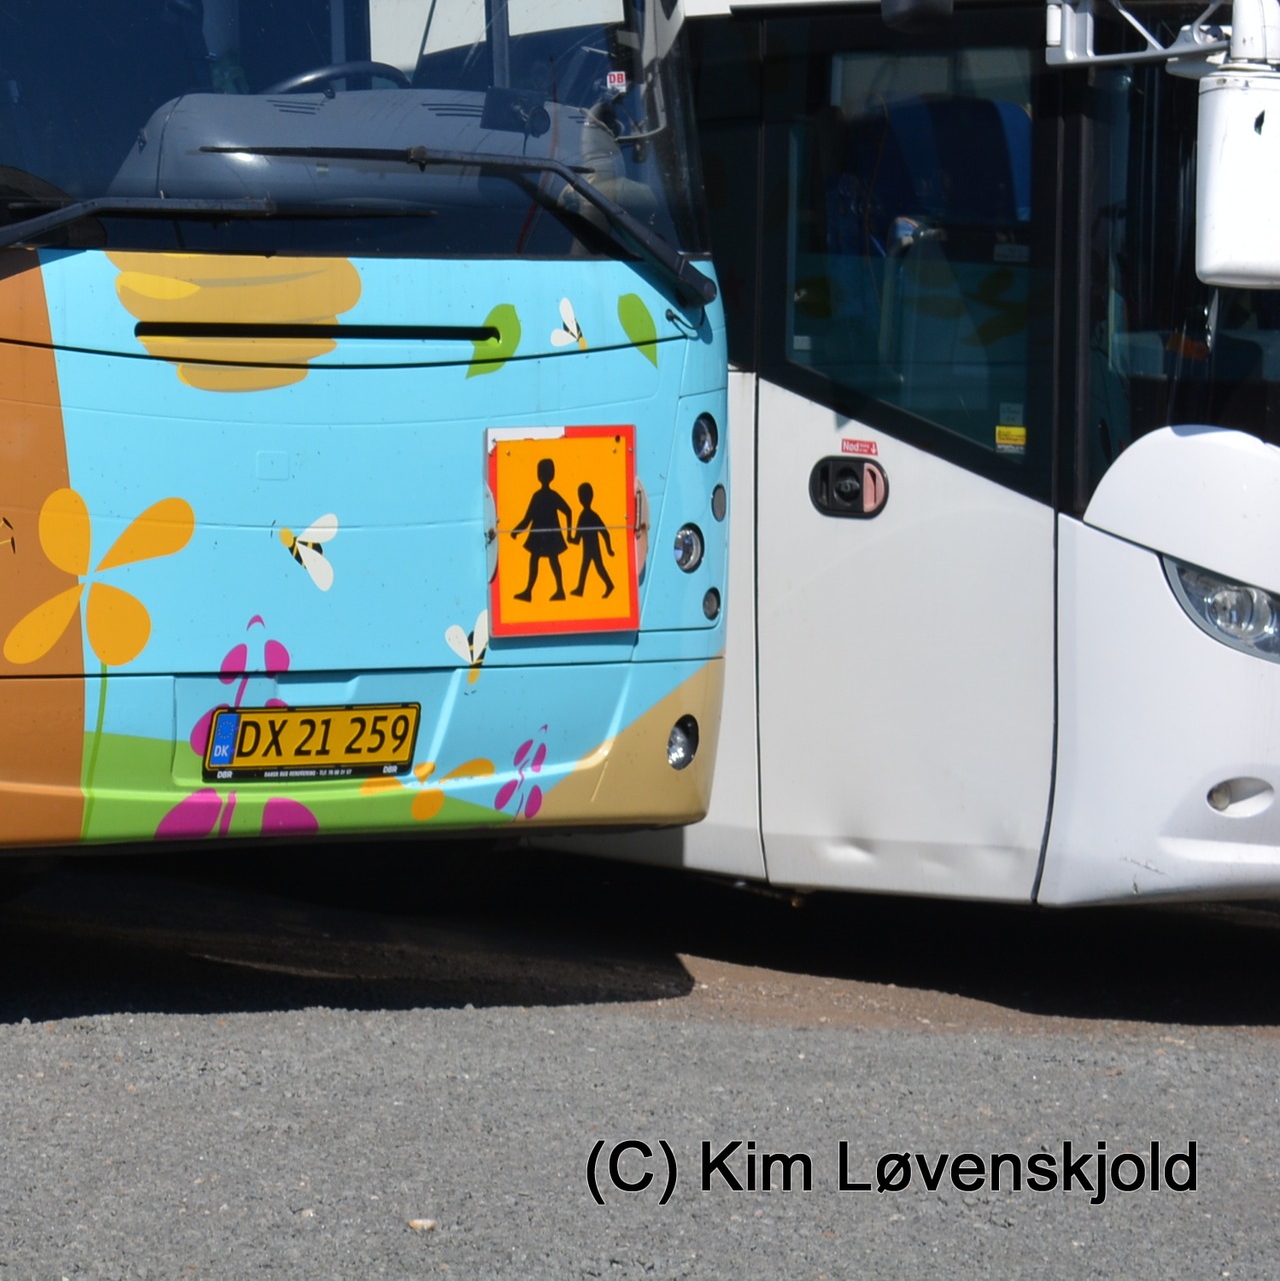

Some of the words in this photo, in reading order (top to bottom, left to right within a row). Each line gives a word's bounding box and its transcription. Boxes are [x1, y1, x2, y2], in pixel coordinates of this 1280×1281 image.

[609, 73, 624, 84] DB
[236, 720, 288, 758] DX
[294, 718, 332, 756] 21
[344, 714, 410, 754] 259
[214, 745, 229, 757] DK
[217, 770, 233, 779] DBR
[383, 765, 398, 774] DBR
